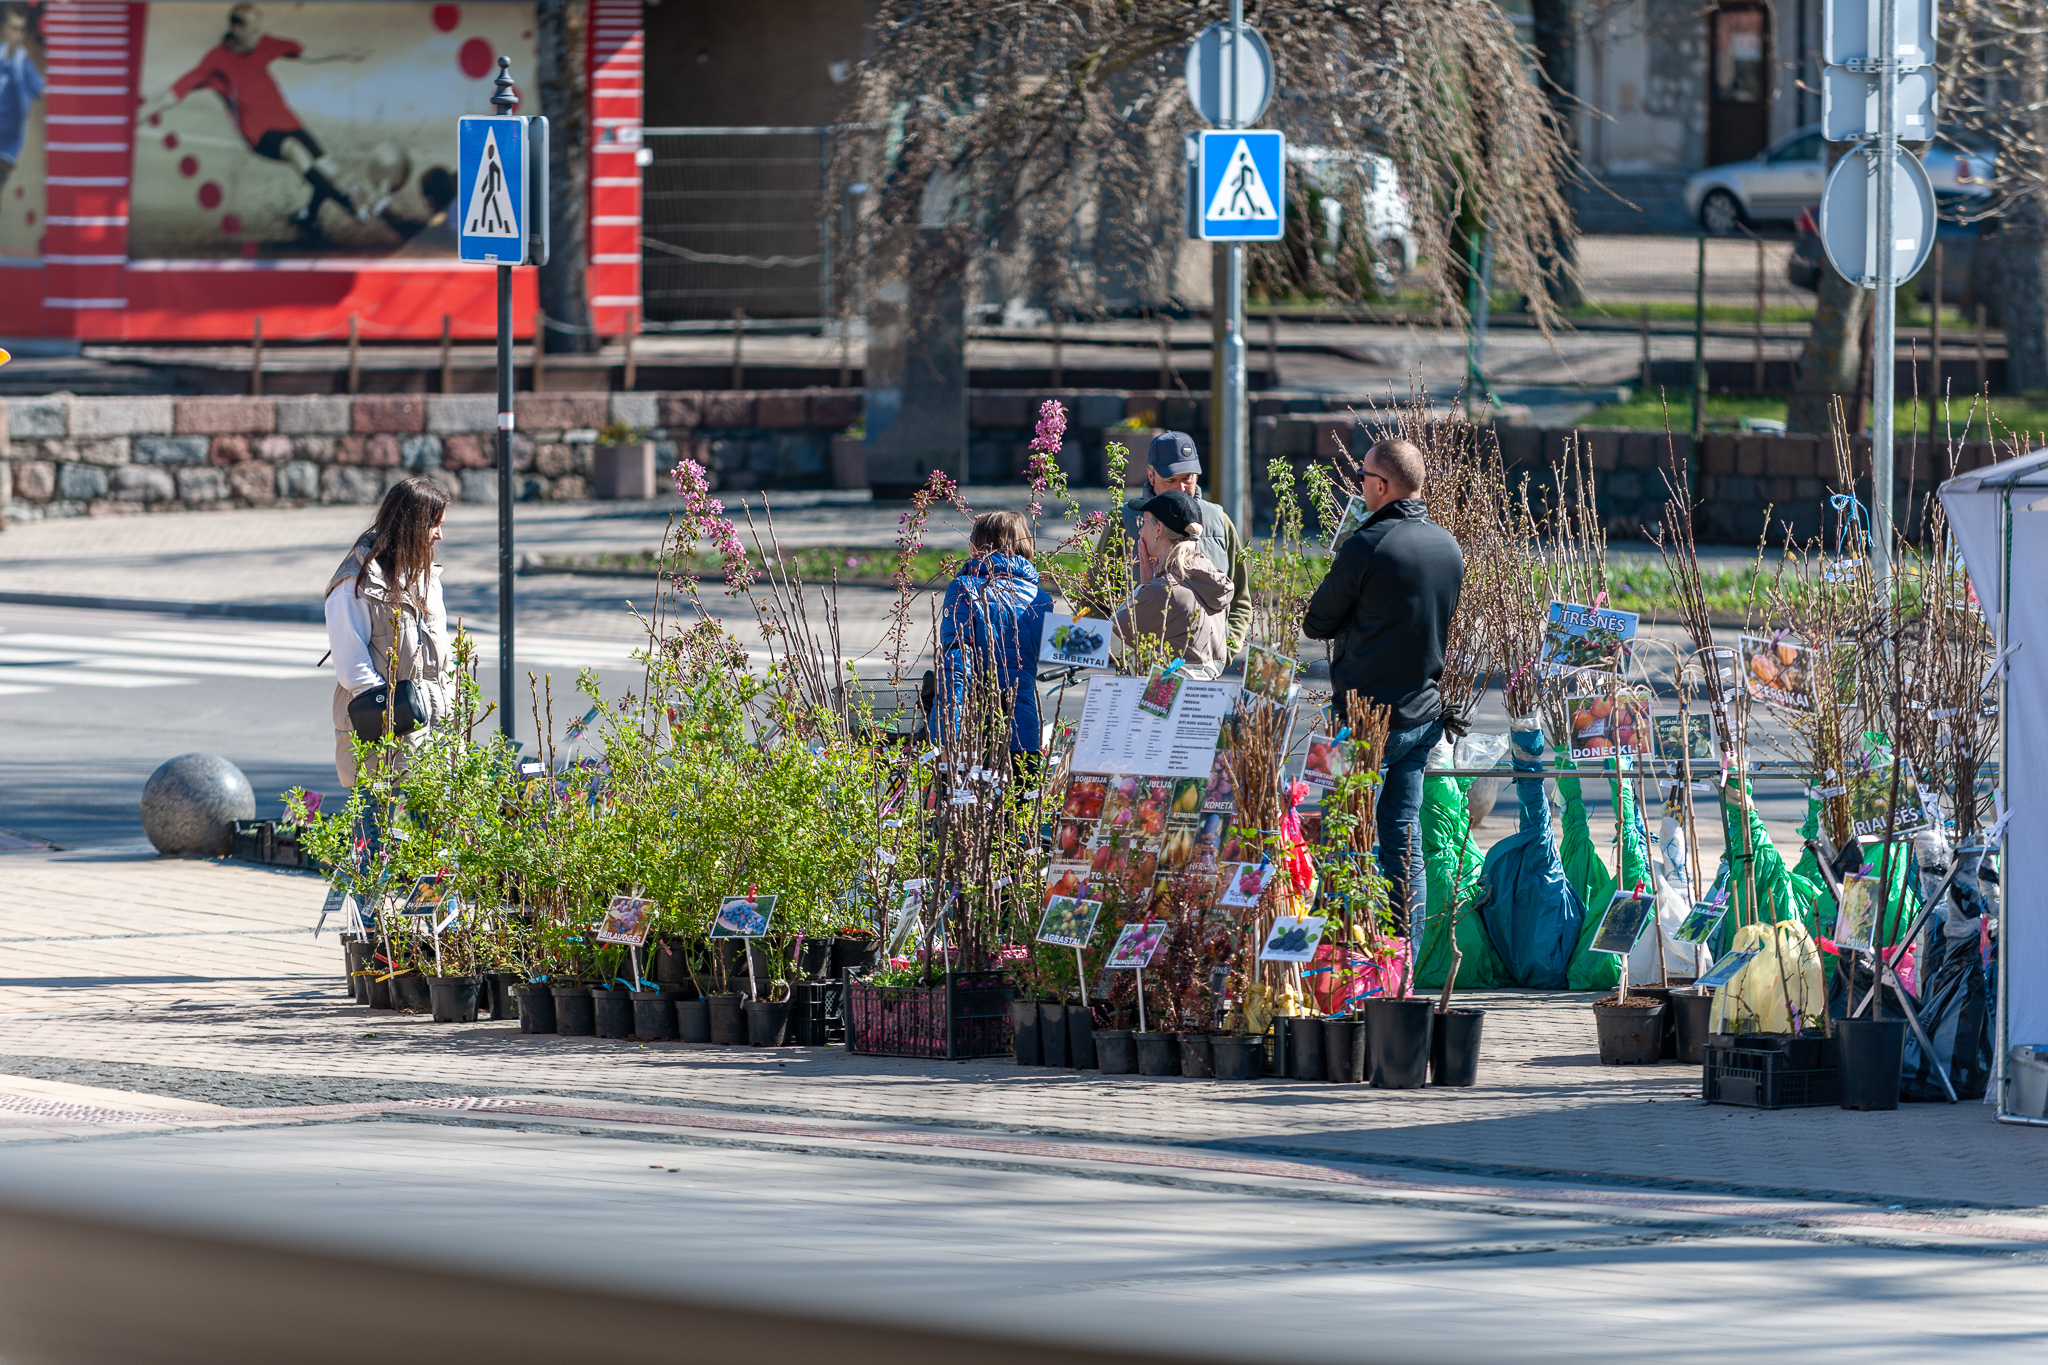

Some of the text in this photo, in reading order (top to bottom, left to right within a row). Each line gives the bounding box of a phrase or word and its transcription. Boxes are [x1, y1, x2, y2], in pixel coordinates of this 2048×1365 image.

[1052, 652, 1104, 667] SERBENTAI
[1756, 684, 1809, 708] PERSIKAI
[1140, 699, 1168, 715] SERBENTAI
[1573, 745, 1639, 758] DONECKIJ
[1075, 775, 1107, 784] BOHEMIJA
[1146, 780, 1172, 789] JULIJA
[1204, 800, 1233, 810] KOMETA
[1043, 933, 1081, 946] AGRASTAI
